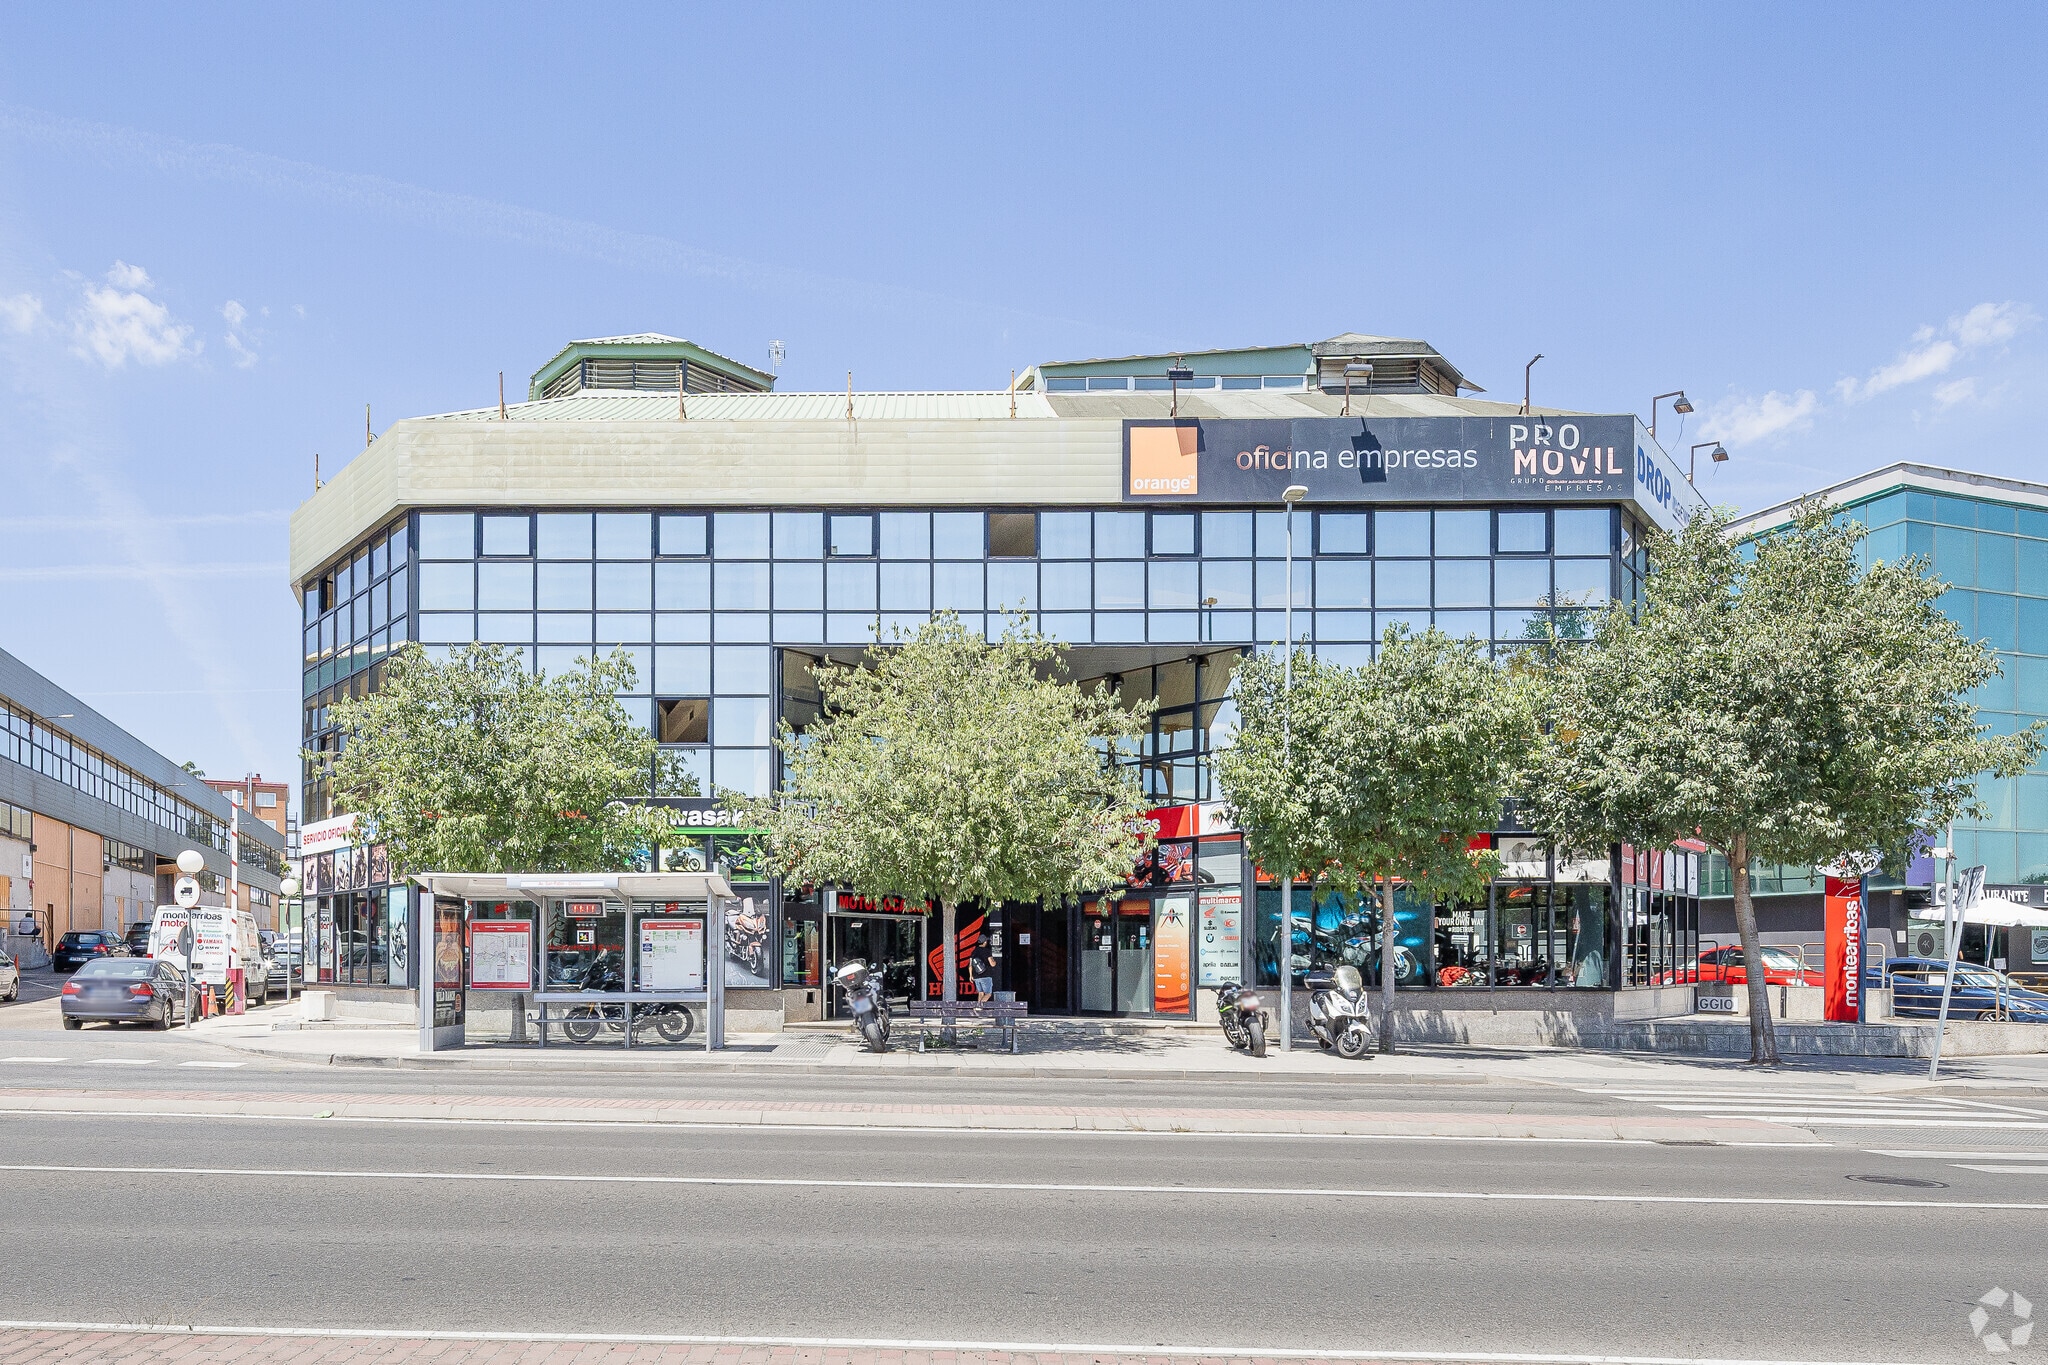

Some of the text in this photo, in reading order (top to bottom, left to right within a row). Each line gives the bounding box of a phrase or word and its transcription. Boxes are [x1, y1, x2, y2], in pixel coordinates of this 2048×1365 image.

[1509, 423, 1580, 450] PRO
[1235, 444, 1478, 474] oficina empresas
[1637, 444, 1671, 510] DROP
[1544, 484, 1623, 492] EMPRESAS
[303, 830, 327, 846] SERVICIO
[1200, 897, 1240, 906] multimarca
[1438, 917, 1484, 926] YOUR OWN WAY
[1843, 900, 1859, 1008] montearribas
[1699, 998, 1734, 1010] GGIO
